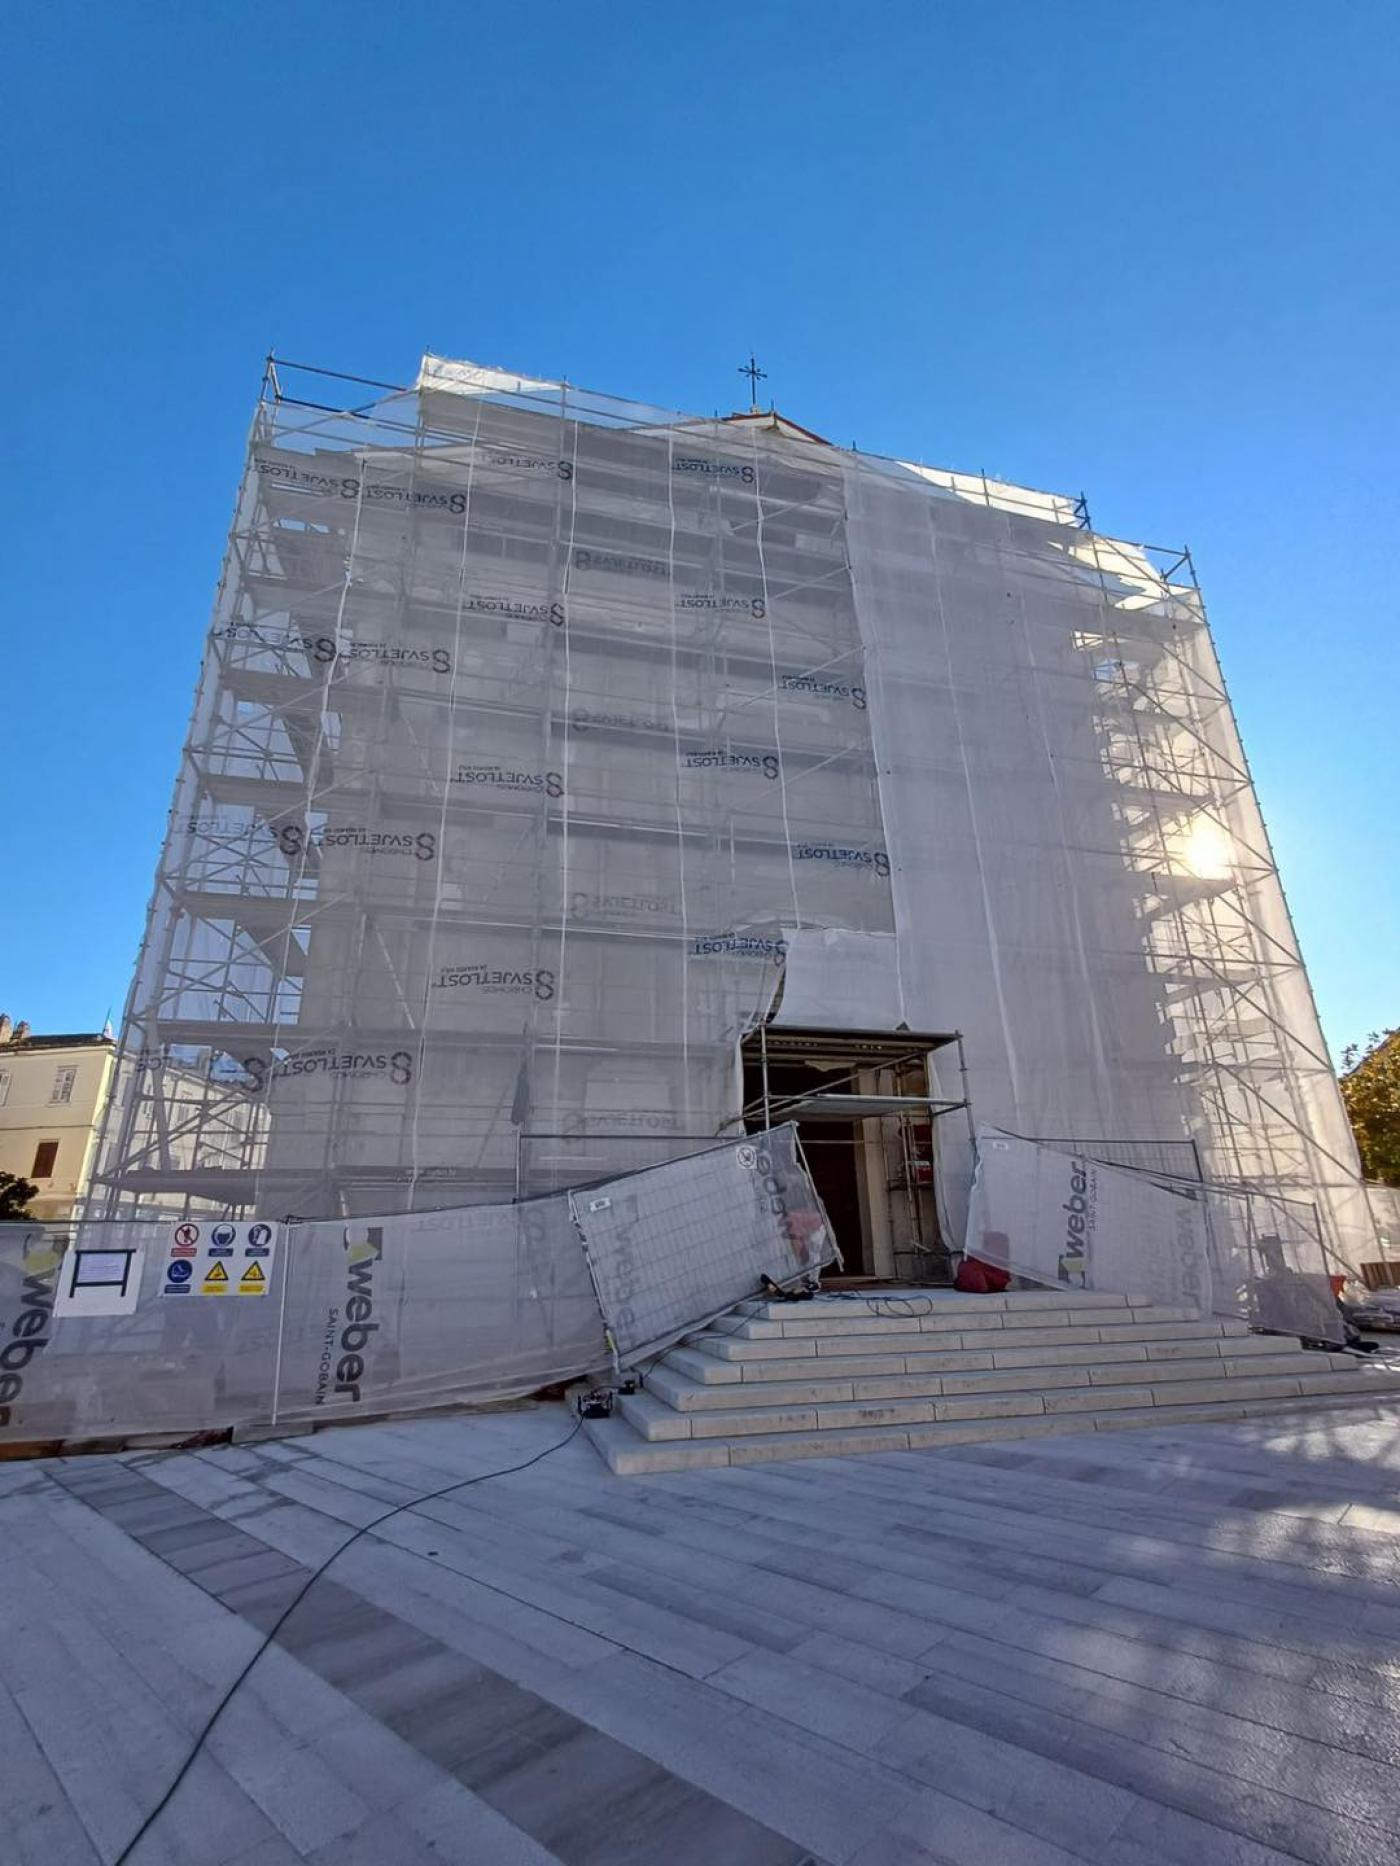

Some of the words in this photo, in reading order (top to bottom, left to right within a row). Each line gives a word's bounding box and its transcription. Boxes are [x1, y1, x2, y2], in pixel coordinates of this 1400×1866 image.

[672, 463, 741, 479] SVJETLOST
[463, 600, 549, 616] SVJETLOST
[778, 681, 850, 699] SVJETLOST
[680, 755, 761, 770] SVJETLOST
[449, 772, 544, 788] SVJETLOST
[311, 833, 414, 849] SVJETLOST
[793, 847, 872, 863] SVJETLOST
[689, 938, 779, 957] SVJETLOST
[431, 971, 534, 989] SVJETLOST
[271, 1051, 388, 1080] SVJETLOST
[1062, 1161, 1087, 1258] weber
[334, 1258, 379, 1402] weber
[315, 1307, 339, 1405] SAINT-GOBAIN
